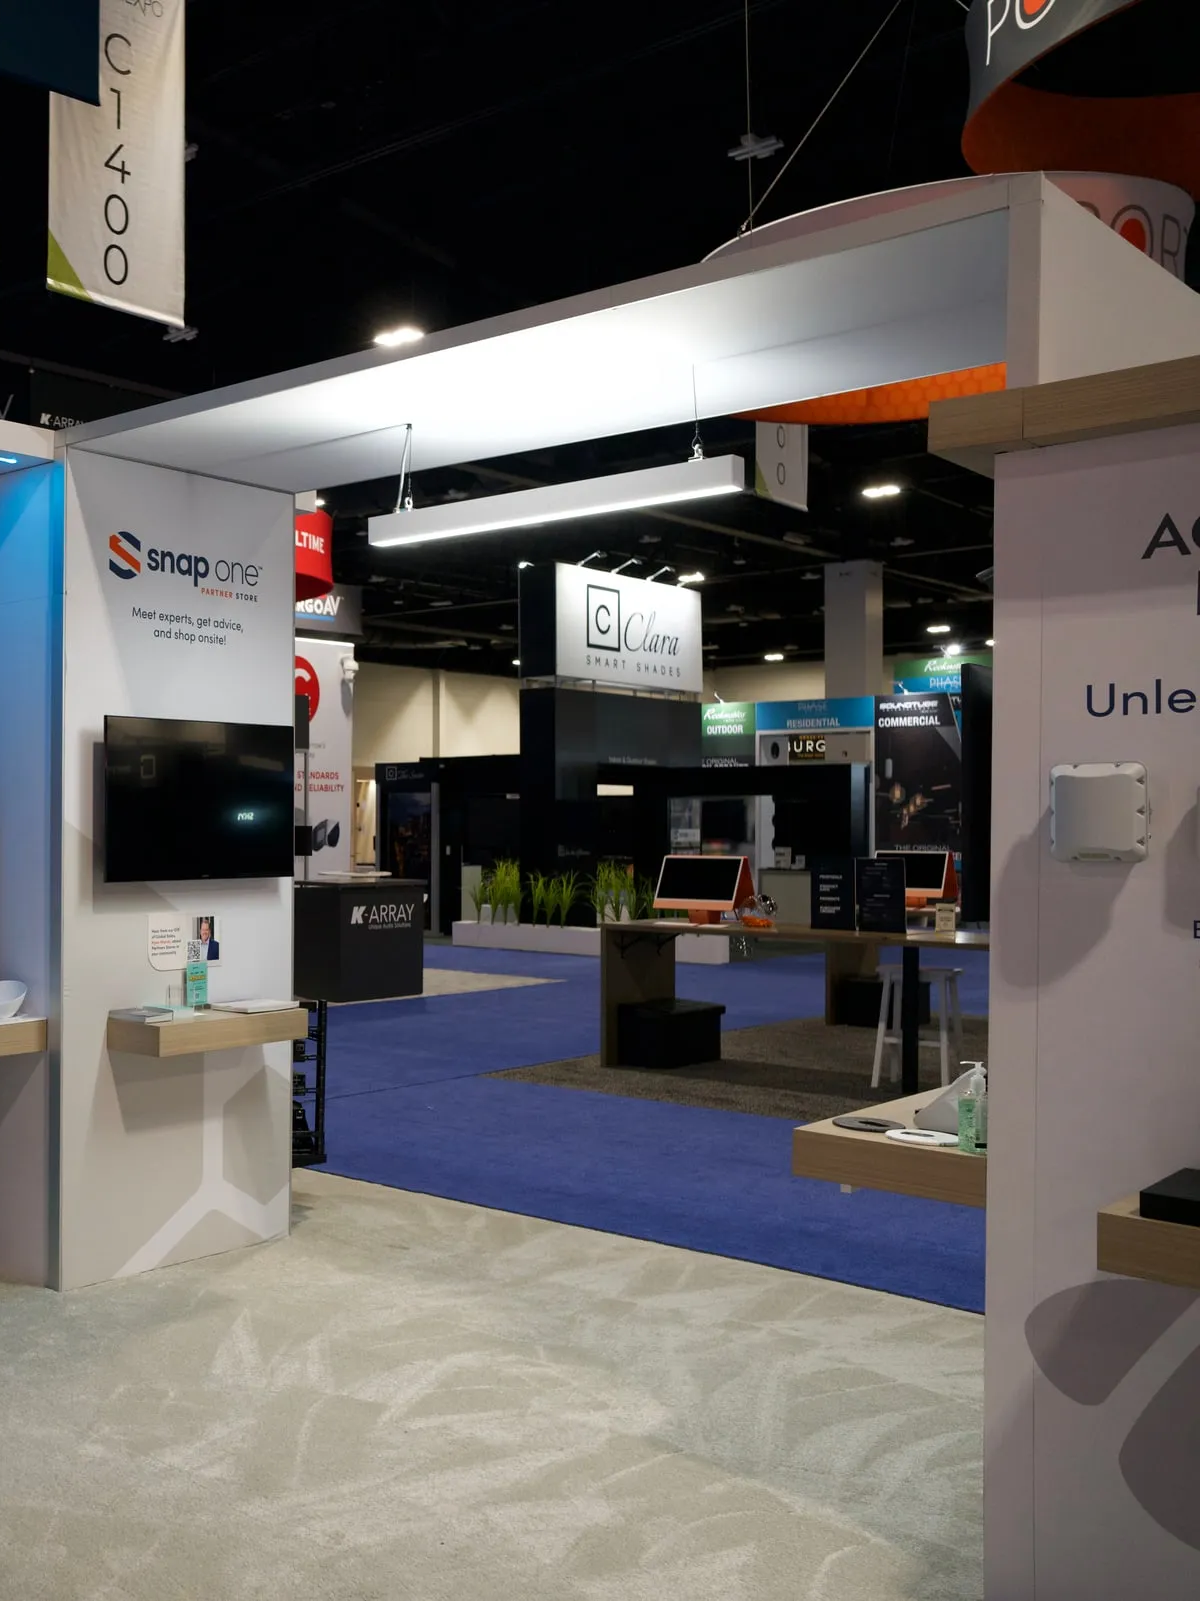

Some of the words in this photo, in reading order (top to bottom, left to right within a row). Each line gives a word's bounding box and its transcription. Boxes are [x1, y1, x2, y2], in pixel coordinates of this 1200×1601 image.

[147, 548, 210, 587] snap
[201, 587, 233, 599] PARTNER
[235, 592, 259, 602] STORE
[132, 606, 157, 621] Meet
[159, 611, 195, 627] experts,
[197, 616, 212, 629] get
[214, 619, 244, 633] advice,
[154, 628, 173, 640] and
[174, 630, 197, 644] shop
[198, 634, 228, 646] onsite!
[624, 610, 680, 656] Clara
[586, 654, 627, 670] SMART
[636, 661, 682, 678] SHADES
[1086, 678, 1197, 719] Unle
[706, 724, 744, 736] OUTDOOR
[786, 718, 841, 729] RESIDENTIAL
[878, 715, 941, 728] COMMERCIAL
[297, 771, 340, 780] STNDARDS
[308, 784, 345, 793] ELIABILITY
[350, 903, 415, 925] K-ARRAY
